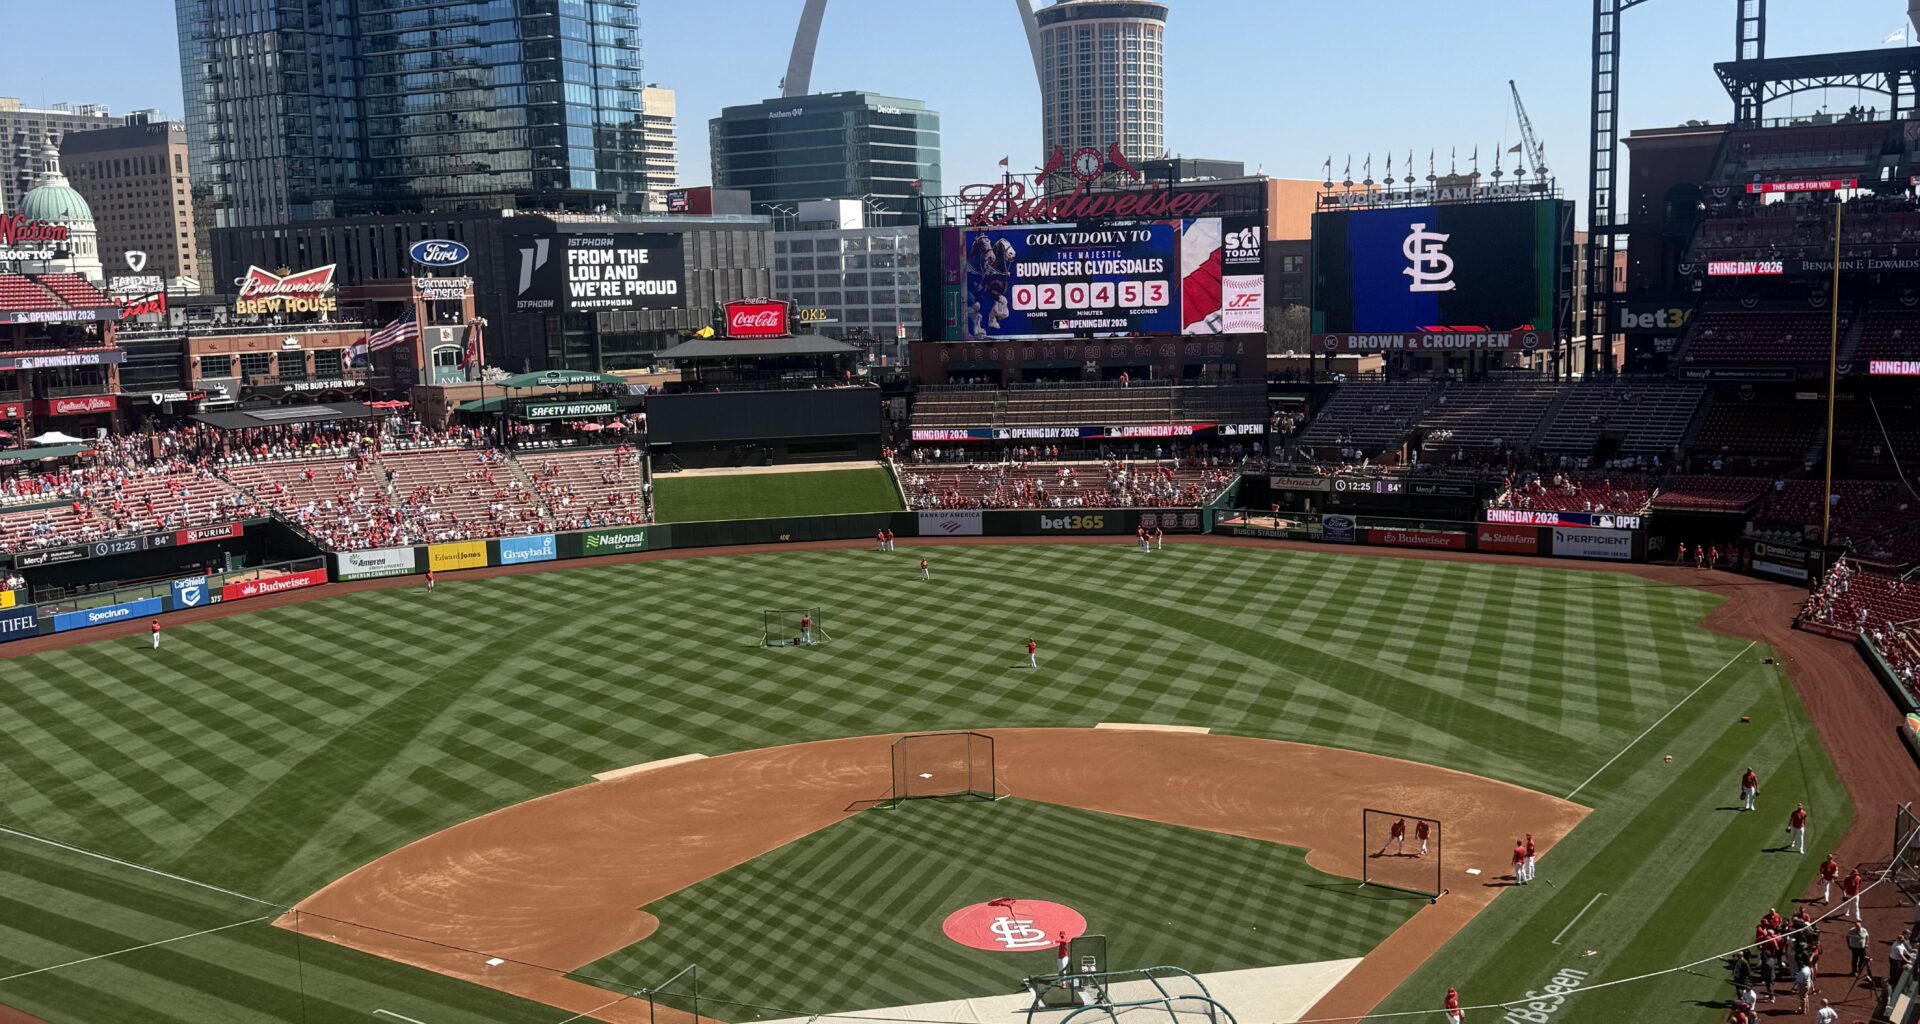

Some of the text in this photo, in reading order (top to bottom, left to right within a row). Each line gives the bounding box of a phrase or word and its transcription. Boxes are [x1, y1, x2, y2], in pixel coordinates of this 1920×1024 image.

[769, 111, 792, 119] Anthem
[1772, 181, 1831, 191] THIS BUD'S FOR YOU
[1337, 184, 1531, 207] WORLD CHAMPIONS
[960, 181, 1219, 225] Budweiser
[0, 214, 67, 245] Nation
[1026, 229, 1151, 247] COUNTDOWN TO
[1225, 226, 1260, 249] stl
[0, 250, 55, 261] ROOFTOP
[424, 242, 458, 262] Ford
[568, 248, 649, 265] FROM THE
[1057, 249, 1122, 260] THE MAJESTIC
[1225, 248, 1260, 258] TODAY
[569, 264, 639, 281] LOU AND
[1016, 258, 1163, 278] BUDWEISER CLYDESDALES
[1737, 262, 1757, 273] DAY
[1758, 261, 1783, 273] 2026
[112, 275, 164, 288] FANDUEL
[234, 276, 334, 298] Budweiser
[417, 278, 470, 290] Community
[569, 279, 678, 297] WE'RE PROUD
[237, 297, 337, 315] BREW HOUSE
[1129, 308, 1158, 316] SECONDS
[30, 310, 96, 323] OPENING DAY 2026
[732, 310, 781, 328] Coca-Cola
[1069, 317, 1128, 329] OPENING DAY 2026
[1348, 333, 1508, 349] BROWN & CROUPPEN
[34, 354, 100, 369] OPENING DAY 2026
[294, 380, 356, 392] THIS BUD'S FOR YOU
[531, 402, 613, 417] SAFETY NATIONAL
[935, 429, 950, 440] DAY
[950, 429, 968, 440] 2026
[1011, 427, 1079, 439] OPENING DAY 2026
[1123, 425, 1193, 437] OPENING DAY 2026
[1274, 478, 1324, 488] Schnucks
[1347, 481, 1371, 491] 12:25
[1041, 515, 1104, 529] bet365
[1328, 516, 1350, 528] Ford
[1515, 510, 1534, 524] DAY
[1535, 512, 1559, 525] 2026
[198, 526, 231, 540] PURINA
[600, 531, 644, 547] National
[1233, 527, 1289, 538] BUSCH STADIUM
[1398, 533, 1450, 545] Budweiser
[110, 540, 136, 553] 12:25
[1567, 534, 1630, 546] PERFICIENT
[23, 556, 43, 565] Mercy
[358, 557, 386, 567] Ameren
[435, 552, 481, 562] Edward Jones
[174, 575, 206, 589] CarShield
[259, 576, 309, 592] Budweiser
[89, 609, 127, 623] Spectrum
